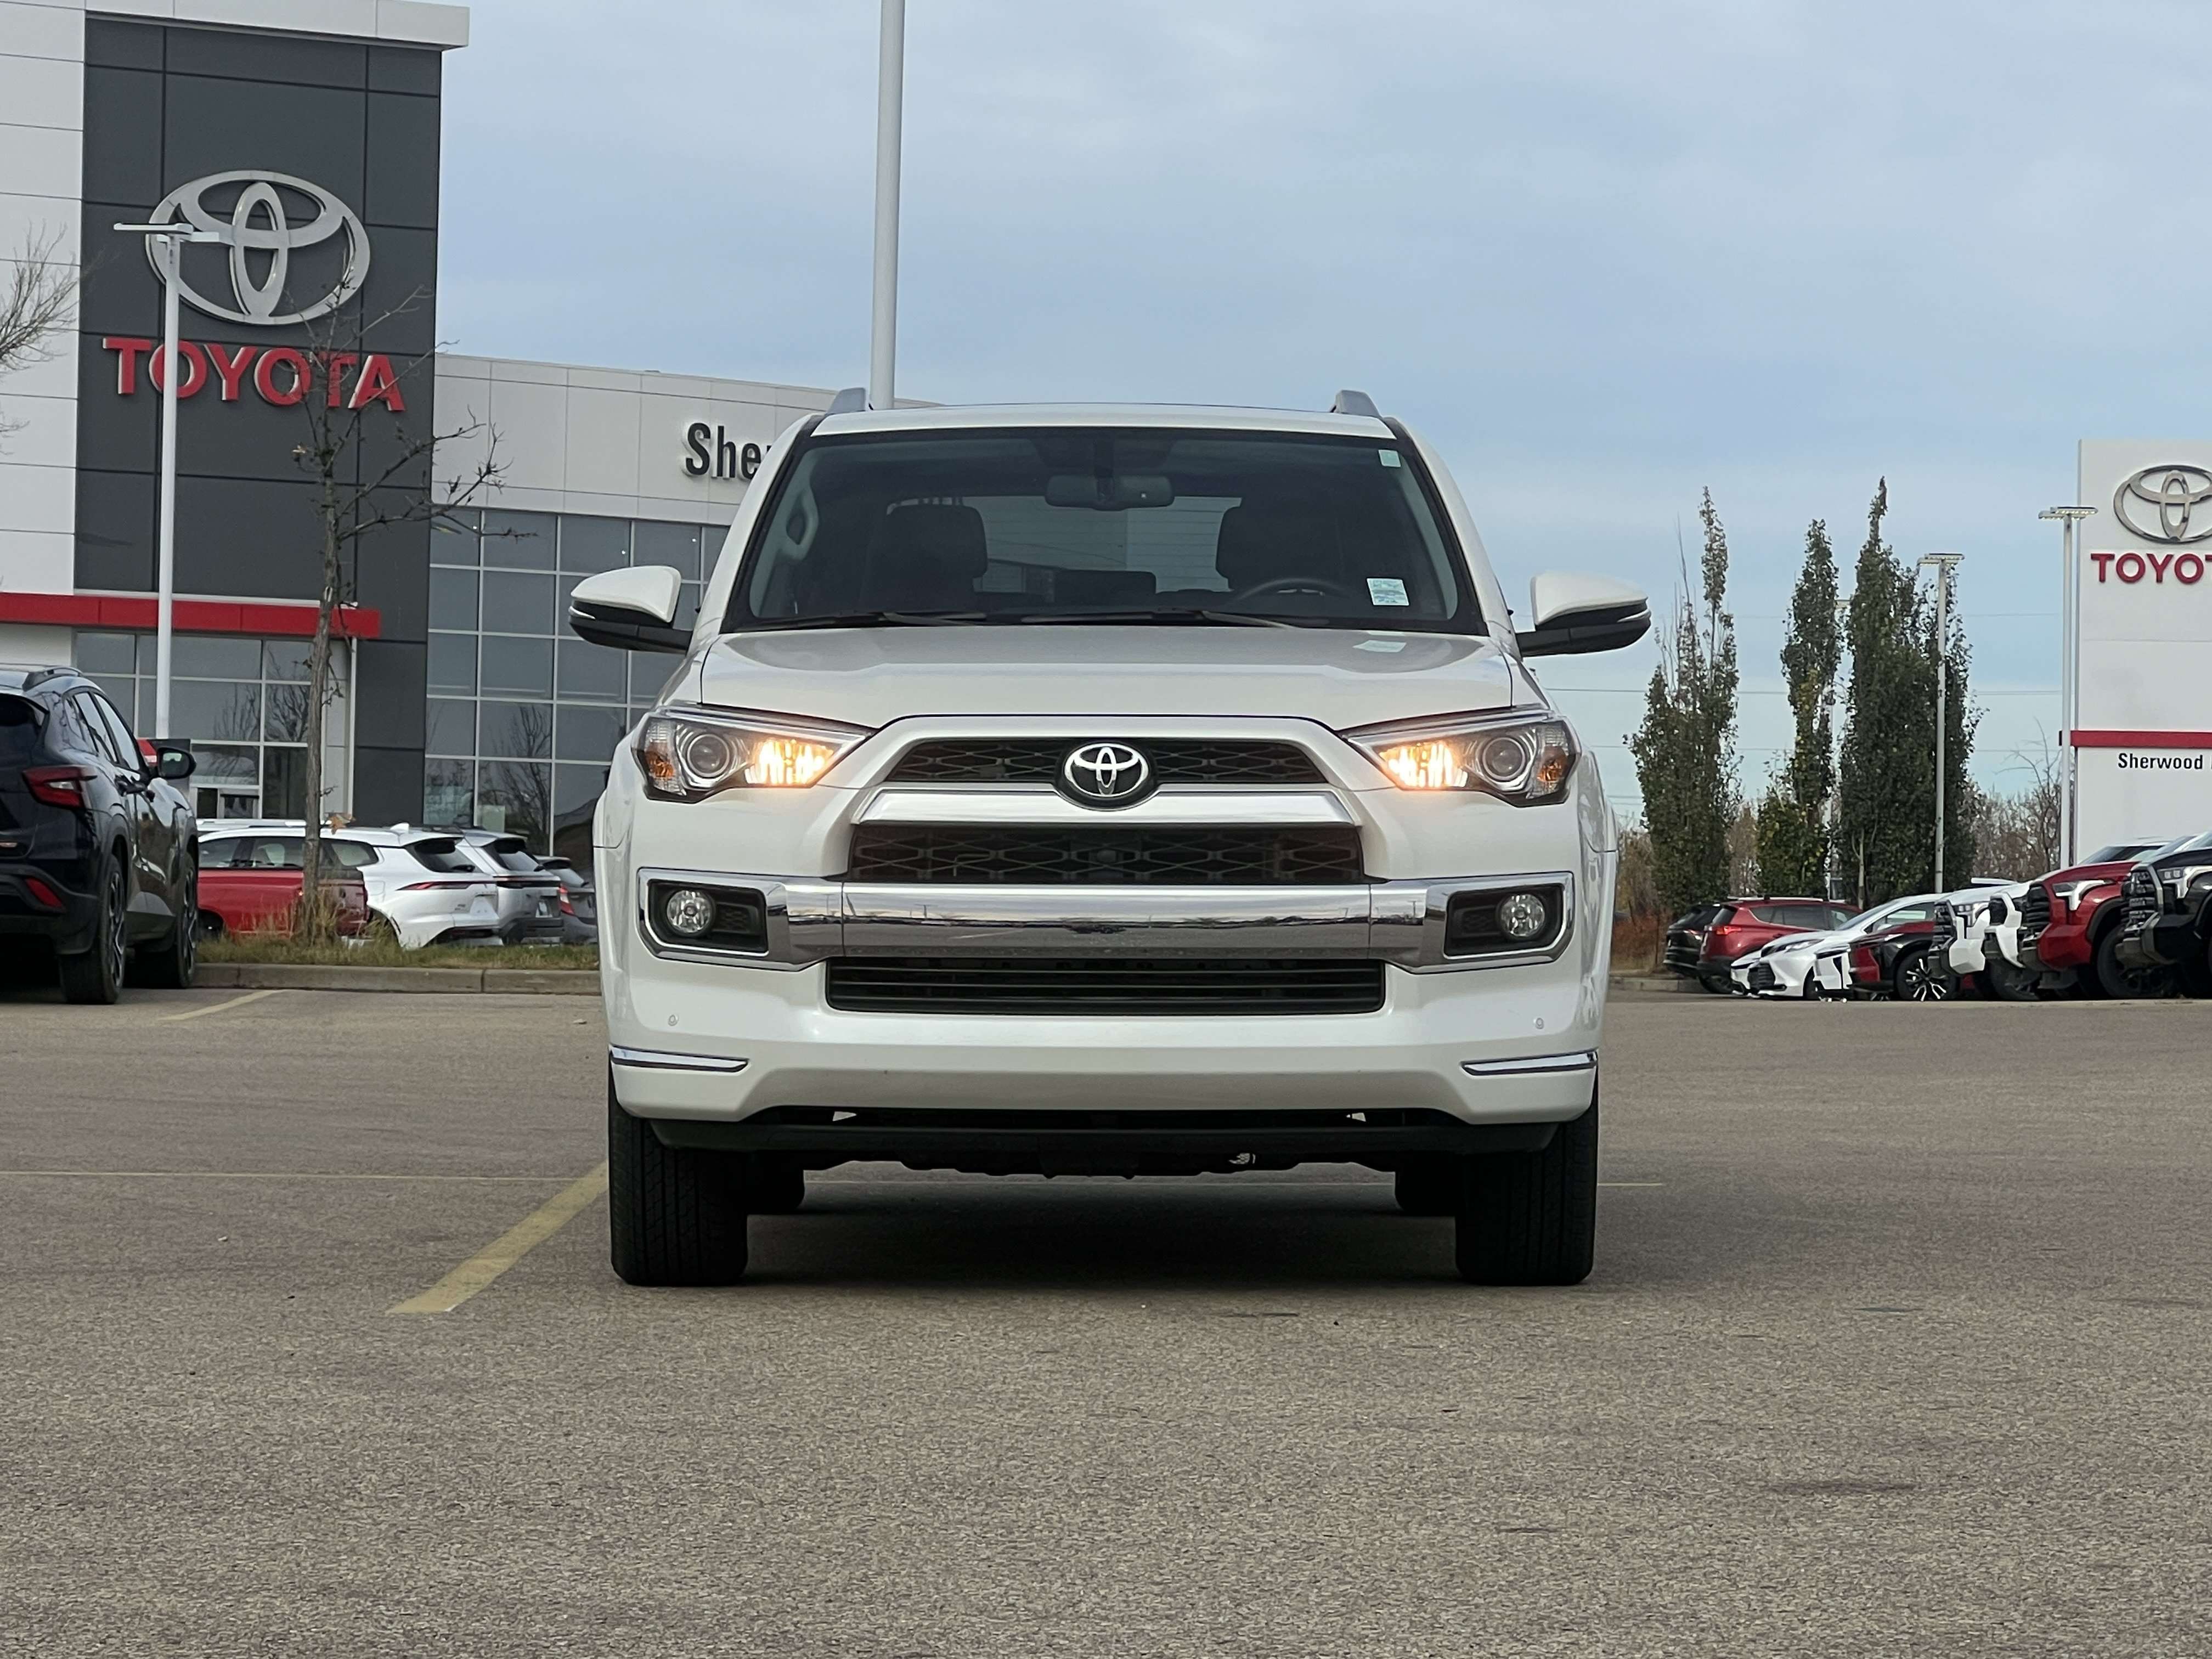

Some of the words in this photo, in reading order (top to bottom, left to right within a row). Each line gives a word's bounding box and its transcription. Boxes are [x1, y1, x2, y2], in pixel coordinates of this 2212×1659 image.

[102, 337, 406, 411] TOYOTA
[685, 422, 771, 480] She
[2090, 552, 2212, 585] TOYO
[2118, 752, 2203, 770] Sherwood
